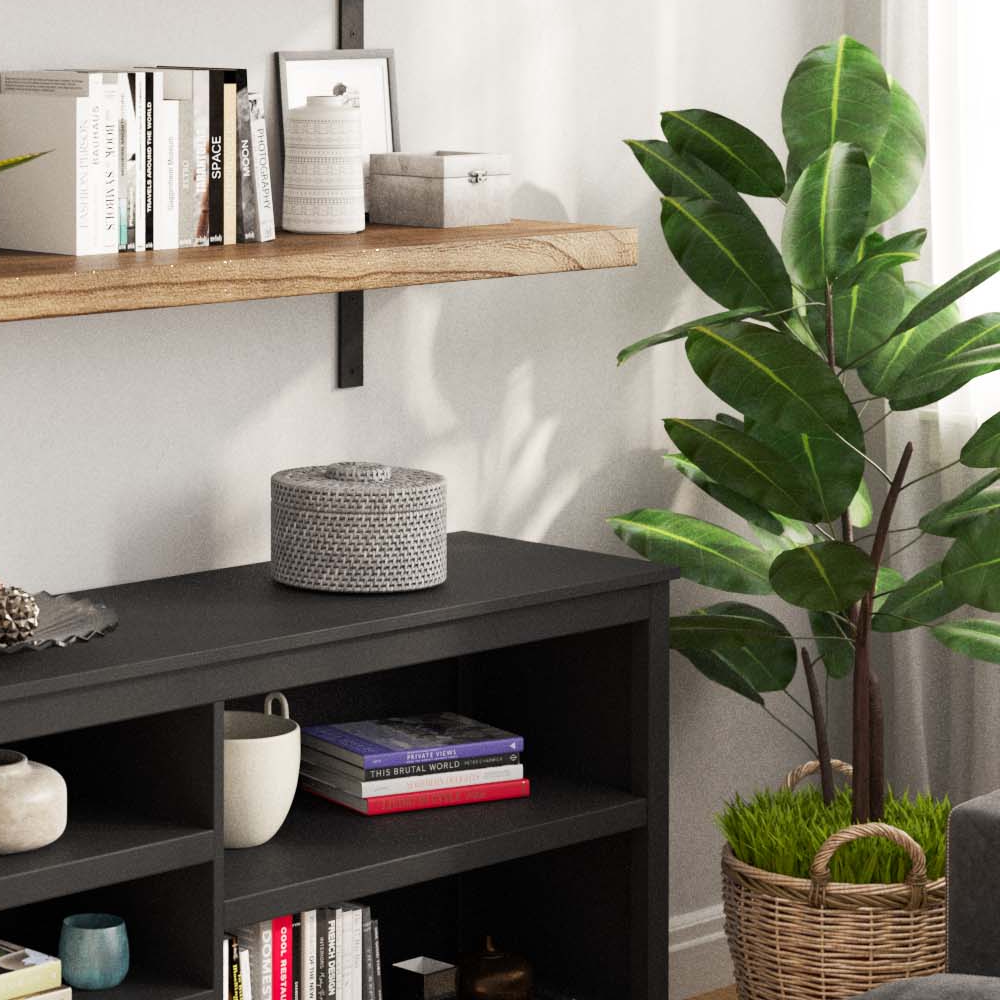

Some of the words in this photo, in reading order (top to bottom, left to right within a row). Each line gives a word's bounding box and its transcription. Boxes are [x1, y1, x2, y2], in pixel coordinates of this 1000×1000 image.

[91, 105, 100, 166] BAUHAUS
[212, 136, 222, 180] SPACE
[242, 139, 250, 177] MOON
[256, 128, 272, 210] PHOTOGRAPHY
[370, 769, 391, 777] THIS
[393, 765, 426, 775] BRUTAL
[429, 760, 461, 770] WORLD
[328, 920, 336, 959] FRENCH
[328, 960, 336, 996] DESIGN
